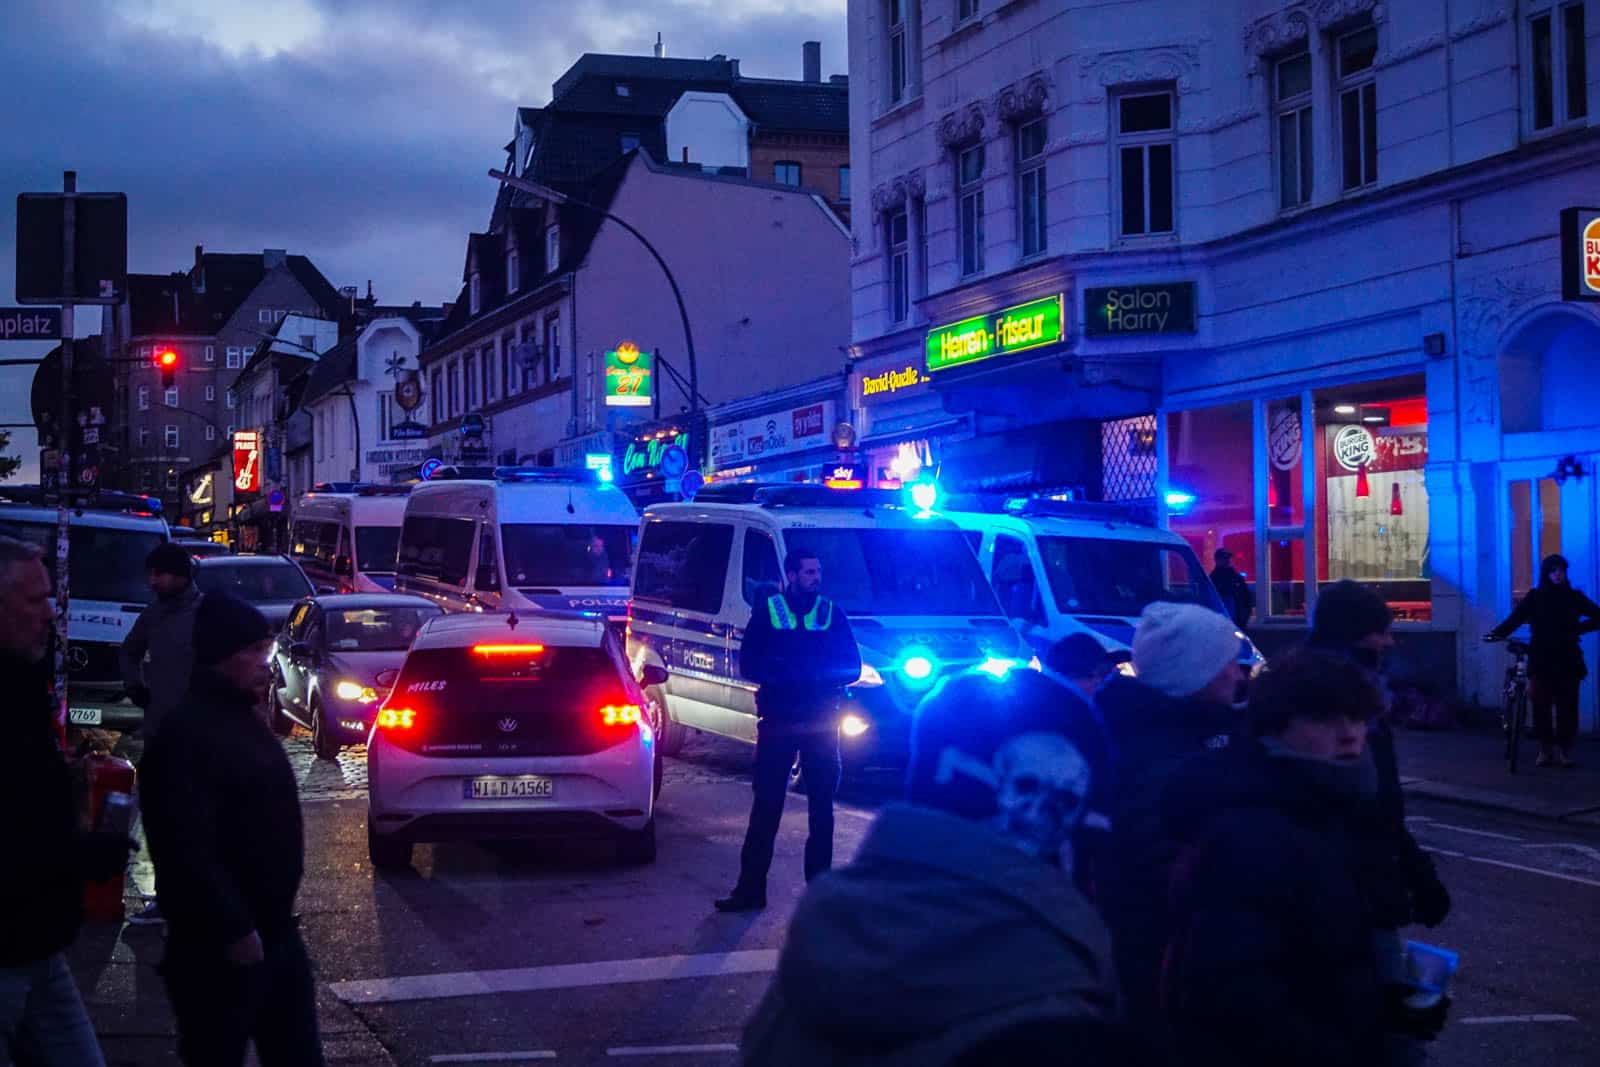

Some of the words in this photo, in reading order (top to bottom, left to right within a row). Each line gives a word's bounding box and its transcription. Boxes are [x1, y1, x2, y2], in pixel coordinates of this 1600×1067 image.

[1107, 288, 1171, 311] Salon
[1107, 309, 1169, 332] Harry
[863, 366, 918, 396] David-Quelle
[1340, 434, 1368, 449] BURGER
[1341, 442, 1370, 458] KING
[833, 466, 854, 481] sky
[407, 680, 447, 693] MILES
[70, 710, 96, 721] 7769
